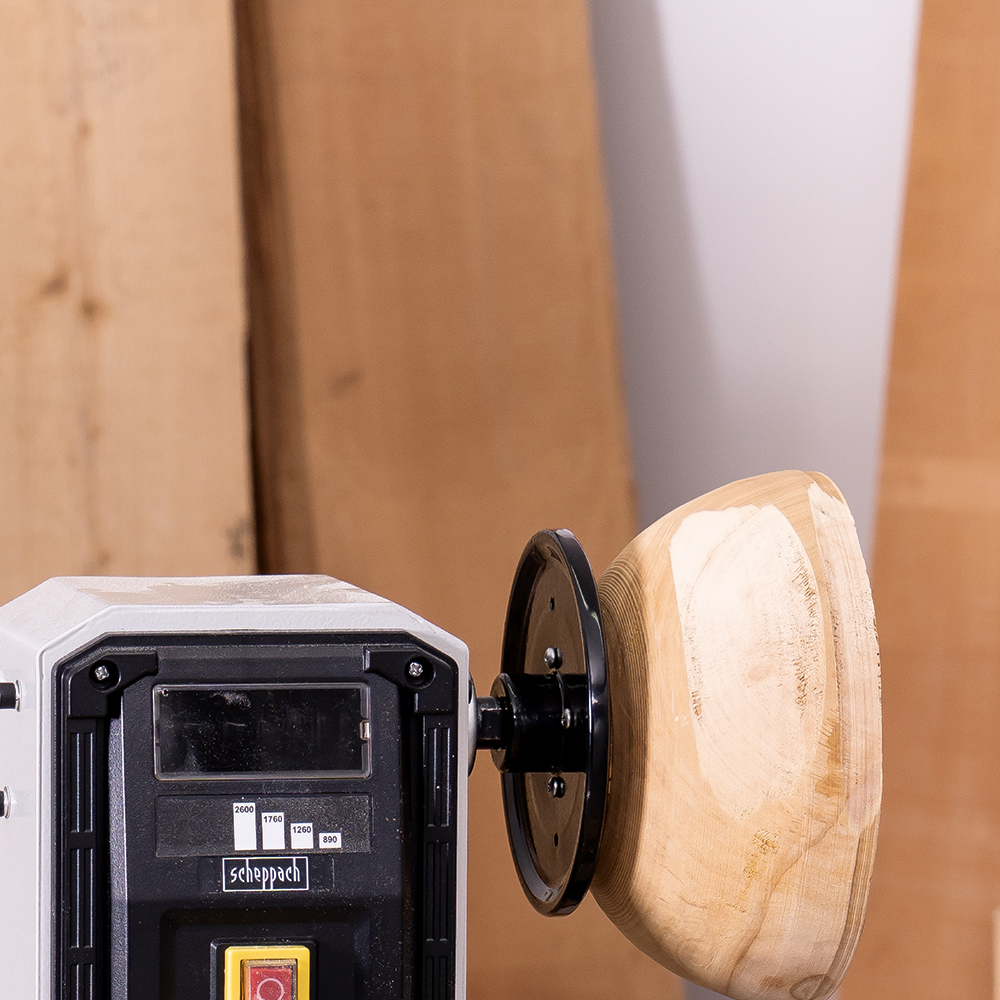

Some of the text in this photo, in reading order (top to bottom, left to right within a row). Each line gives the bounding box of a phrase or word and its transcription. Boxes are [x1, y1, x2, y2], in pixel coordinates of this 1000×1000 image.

[235, 805, 254, 813] 2600
[263, 815, 283, 823] 1760
[322, 835, 338, 843] 890
[230, 859, 301, 889] scheppach
